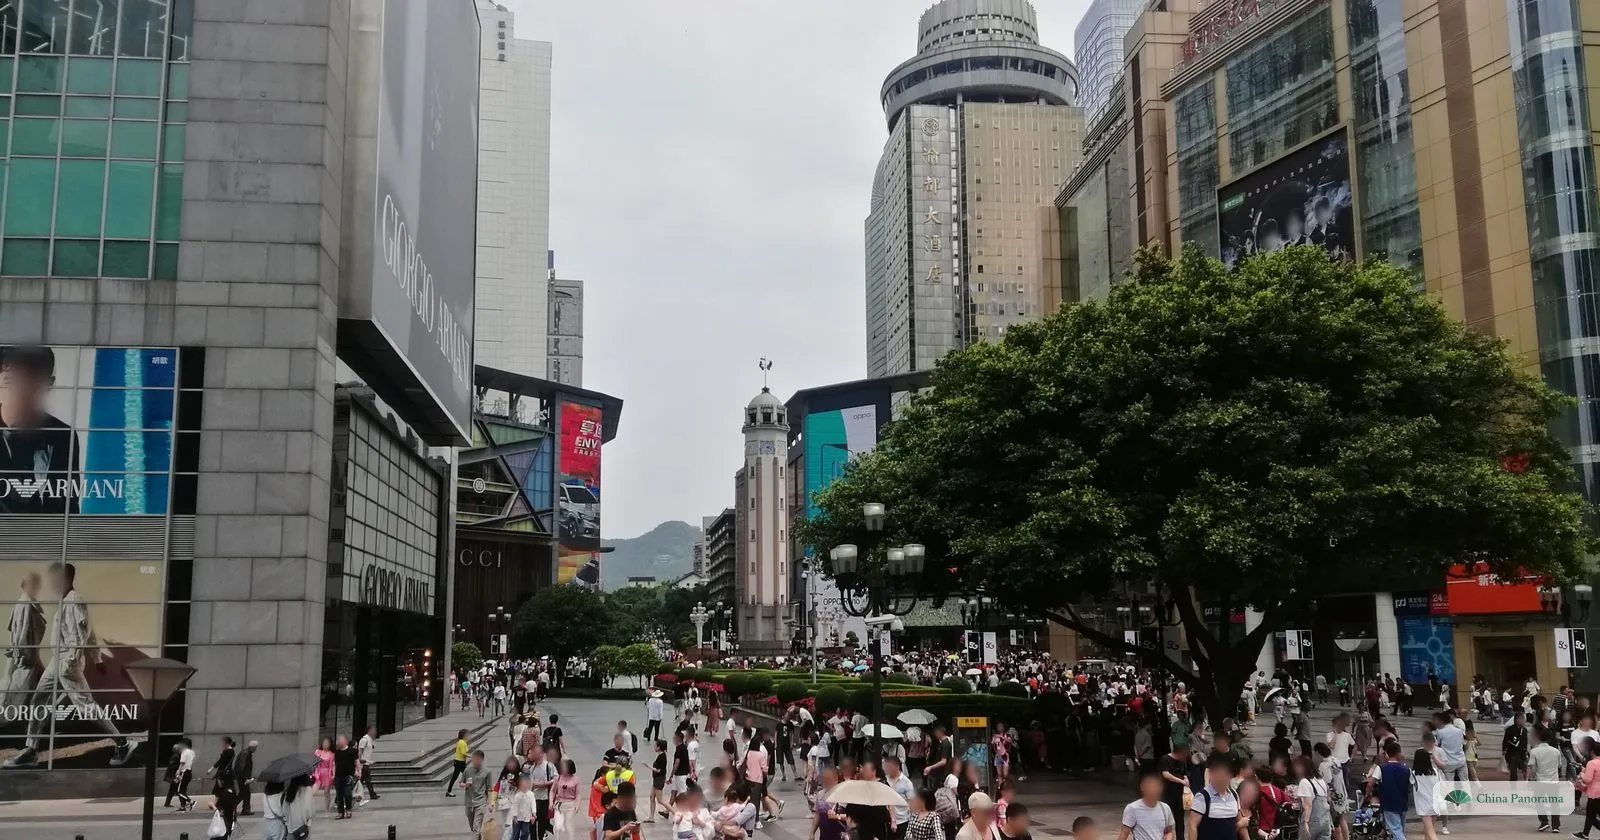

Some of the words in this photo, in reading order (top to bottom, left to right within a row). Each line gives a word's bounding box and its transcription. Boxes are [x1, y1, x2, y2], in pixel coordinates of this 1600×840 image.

[921, 147, 942, 284] 渝都大酒店
[382, 194, 435, 334] GIORGIO
[436, 296, 470, 391] ARMANI
[40, 479, 124, 498] ARMANI
[365, 564, 402, 608] GIORGIO
[402, 576, 429, 614] ARMANI
[71, 704, 138, 721] ARMANI
